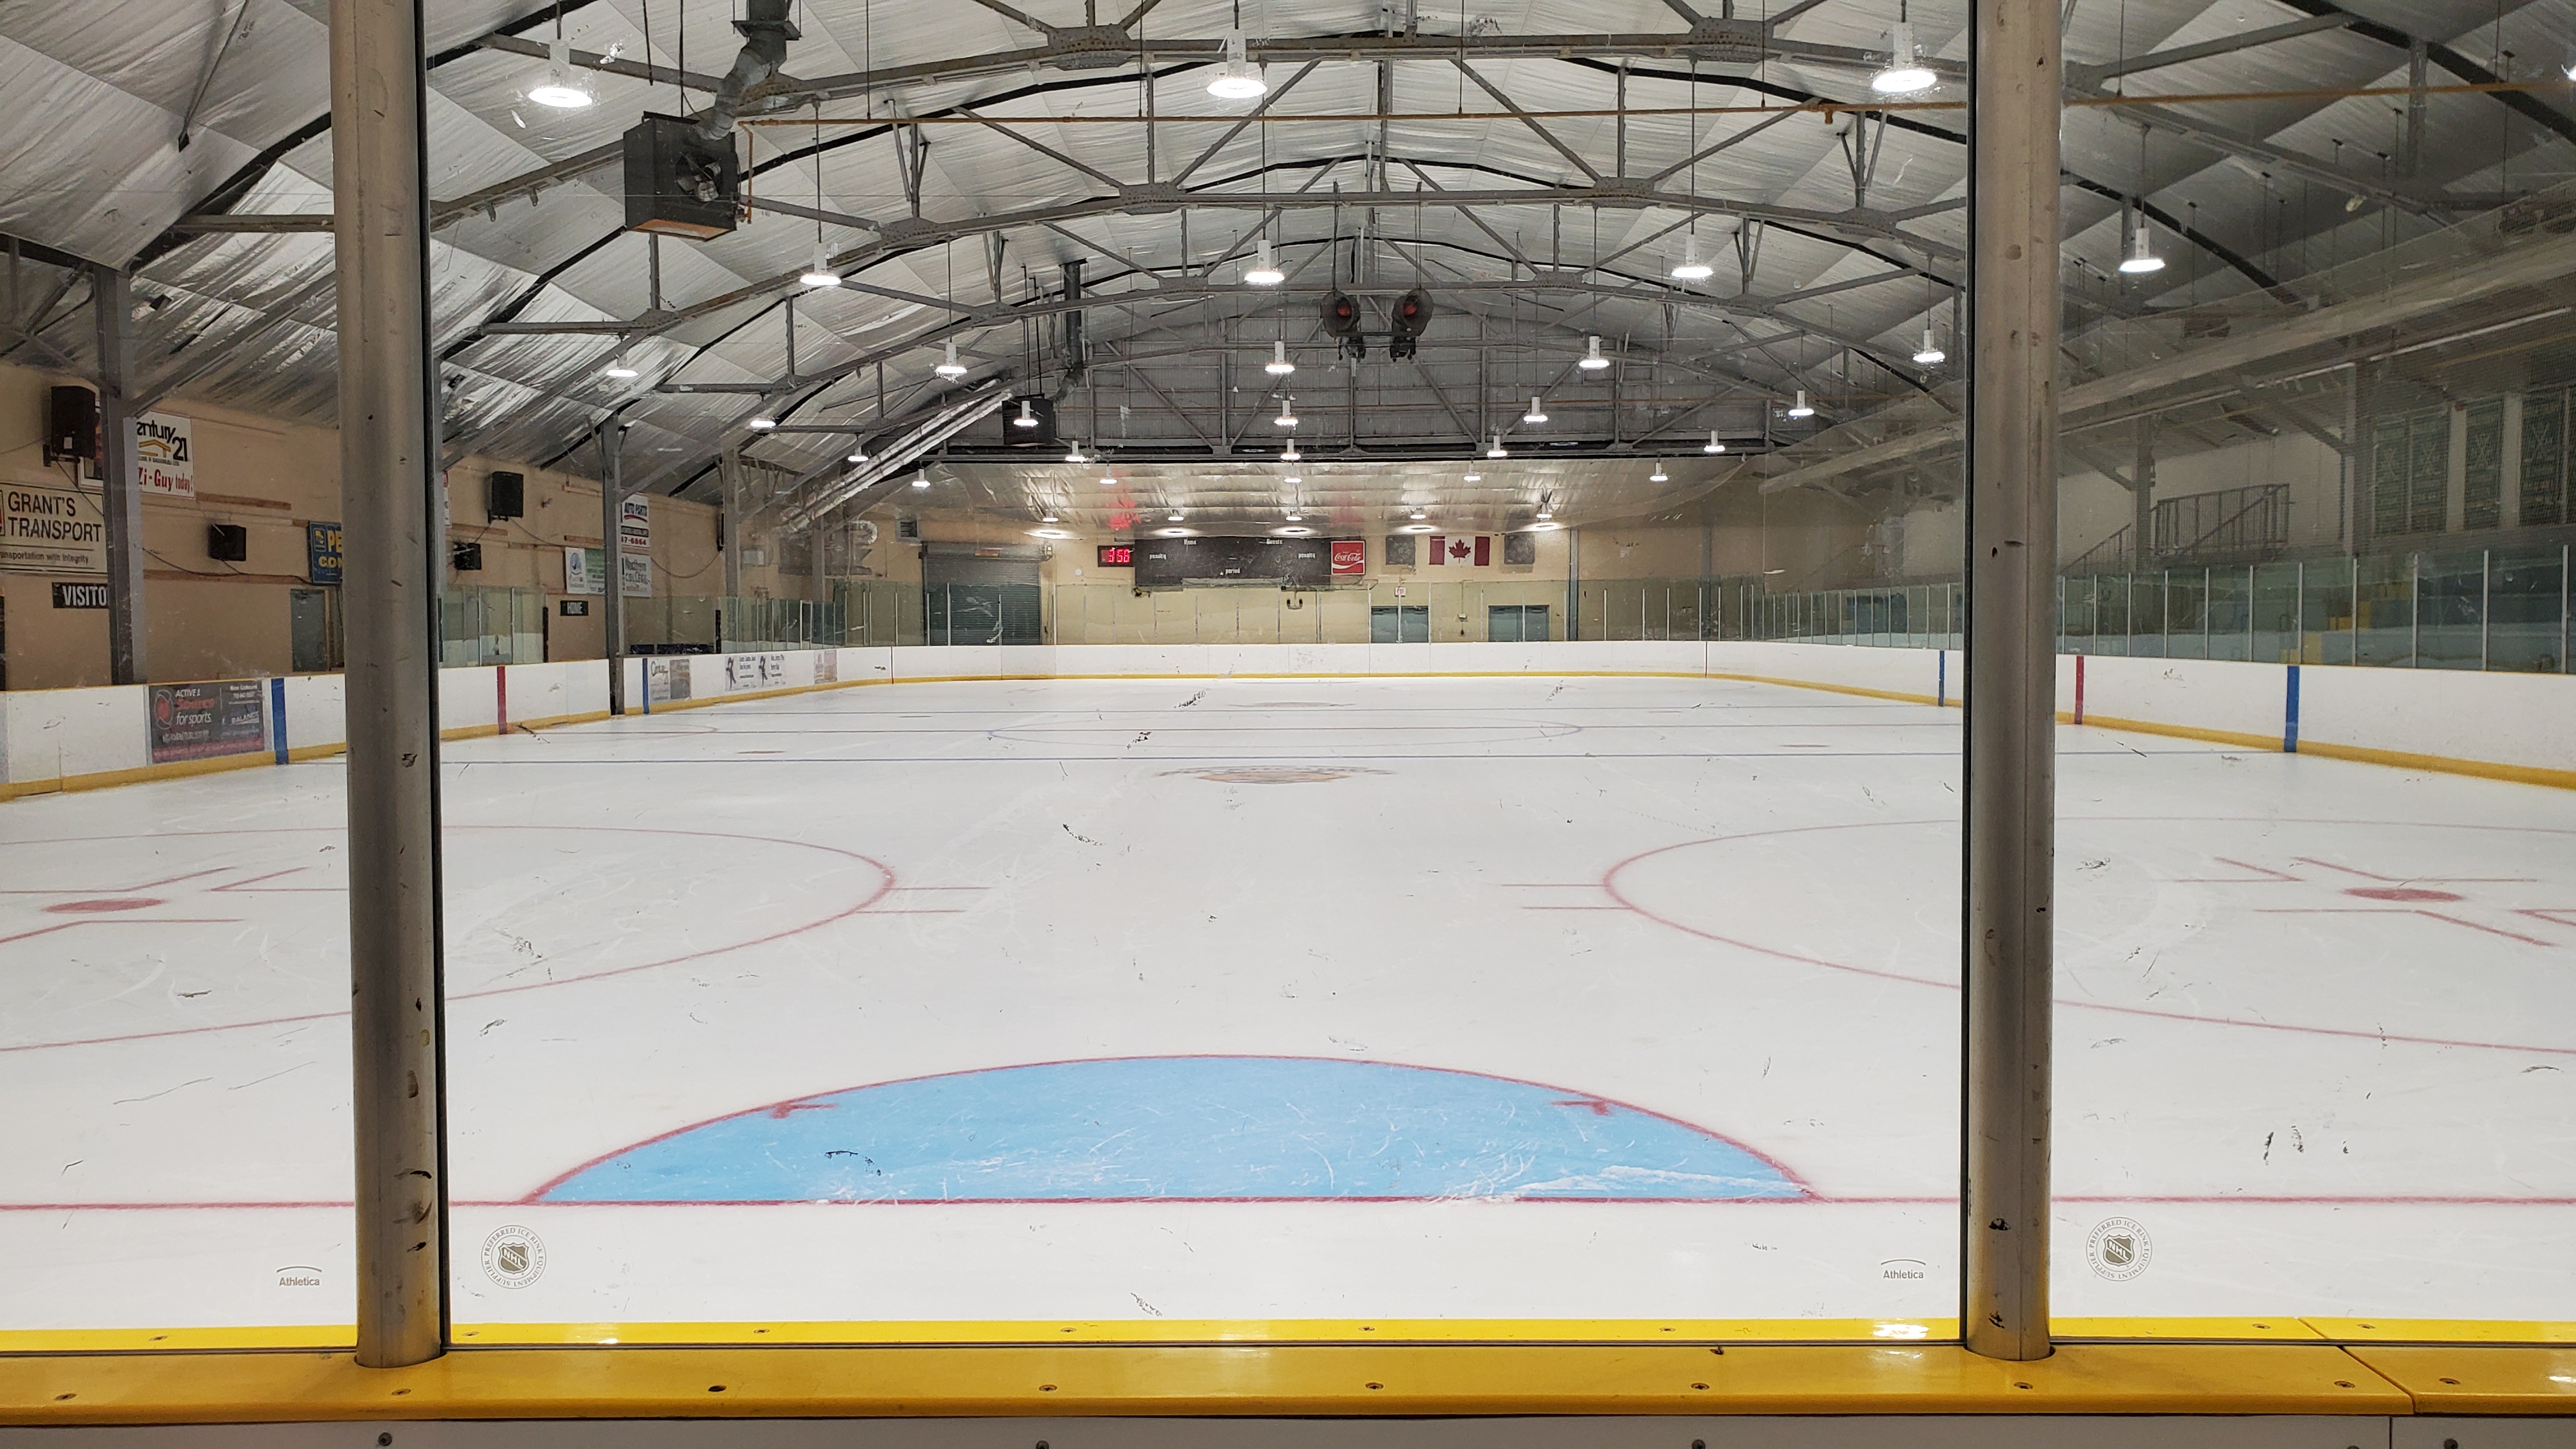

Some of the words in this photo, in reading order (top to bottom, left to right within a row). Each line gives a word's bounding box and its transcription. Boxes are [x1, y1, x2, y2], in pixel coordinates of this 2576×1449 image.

[137, 420, 176, 443] entury
[172, 436, 188, 462] 21
[8, 491, 76, 517] GRANT'S
[8, 517, 102, 542] TRANSPORT
[0, 551, 45, 561] ansportation
[62, 585, 107, 606] VISITO
[175, 689, 197, 698] ACTIVE
[176, 712, 188, 726] for
[188, 712, 212, 727] sports
[518, 1228, 530, 1238] ICE
[2089, 1220, 2121, 1248] PREFERRED
[2124, 1221, 2136, 1229] ICE
[484, 1227, 516, 1256] PREFERRED
[530, 1236, 542, 1254] RINK
[2136, 1228, 2149, 1246] RINK
[503, 1248, 524, 1268] NHL
[2109, 1241, 2129, 1260] NHL
[485, 1259, 510, 1286] SUPPLIER
[514, 1256, 544, 1287] EQUIPMENT
[1883, 1269, 1924, 1278] Athletica
[2089, 1252, 2115, 1278] SUPPLIER
[2119, 1248, 2149, 1279] EQUIPMENT
[279, 1276, 319, 1286] Athletica
